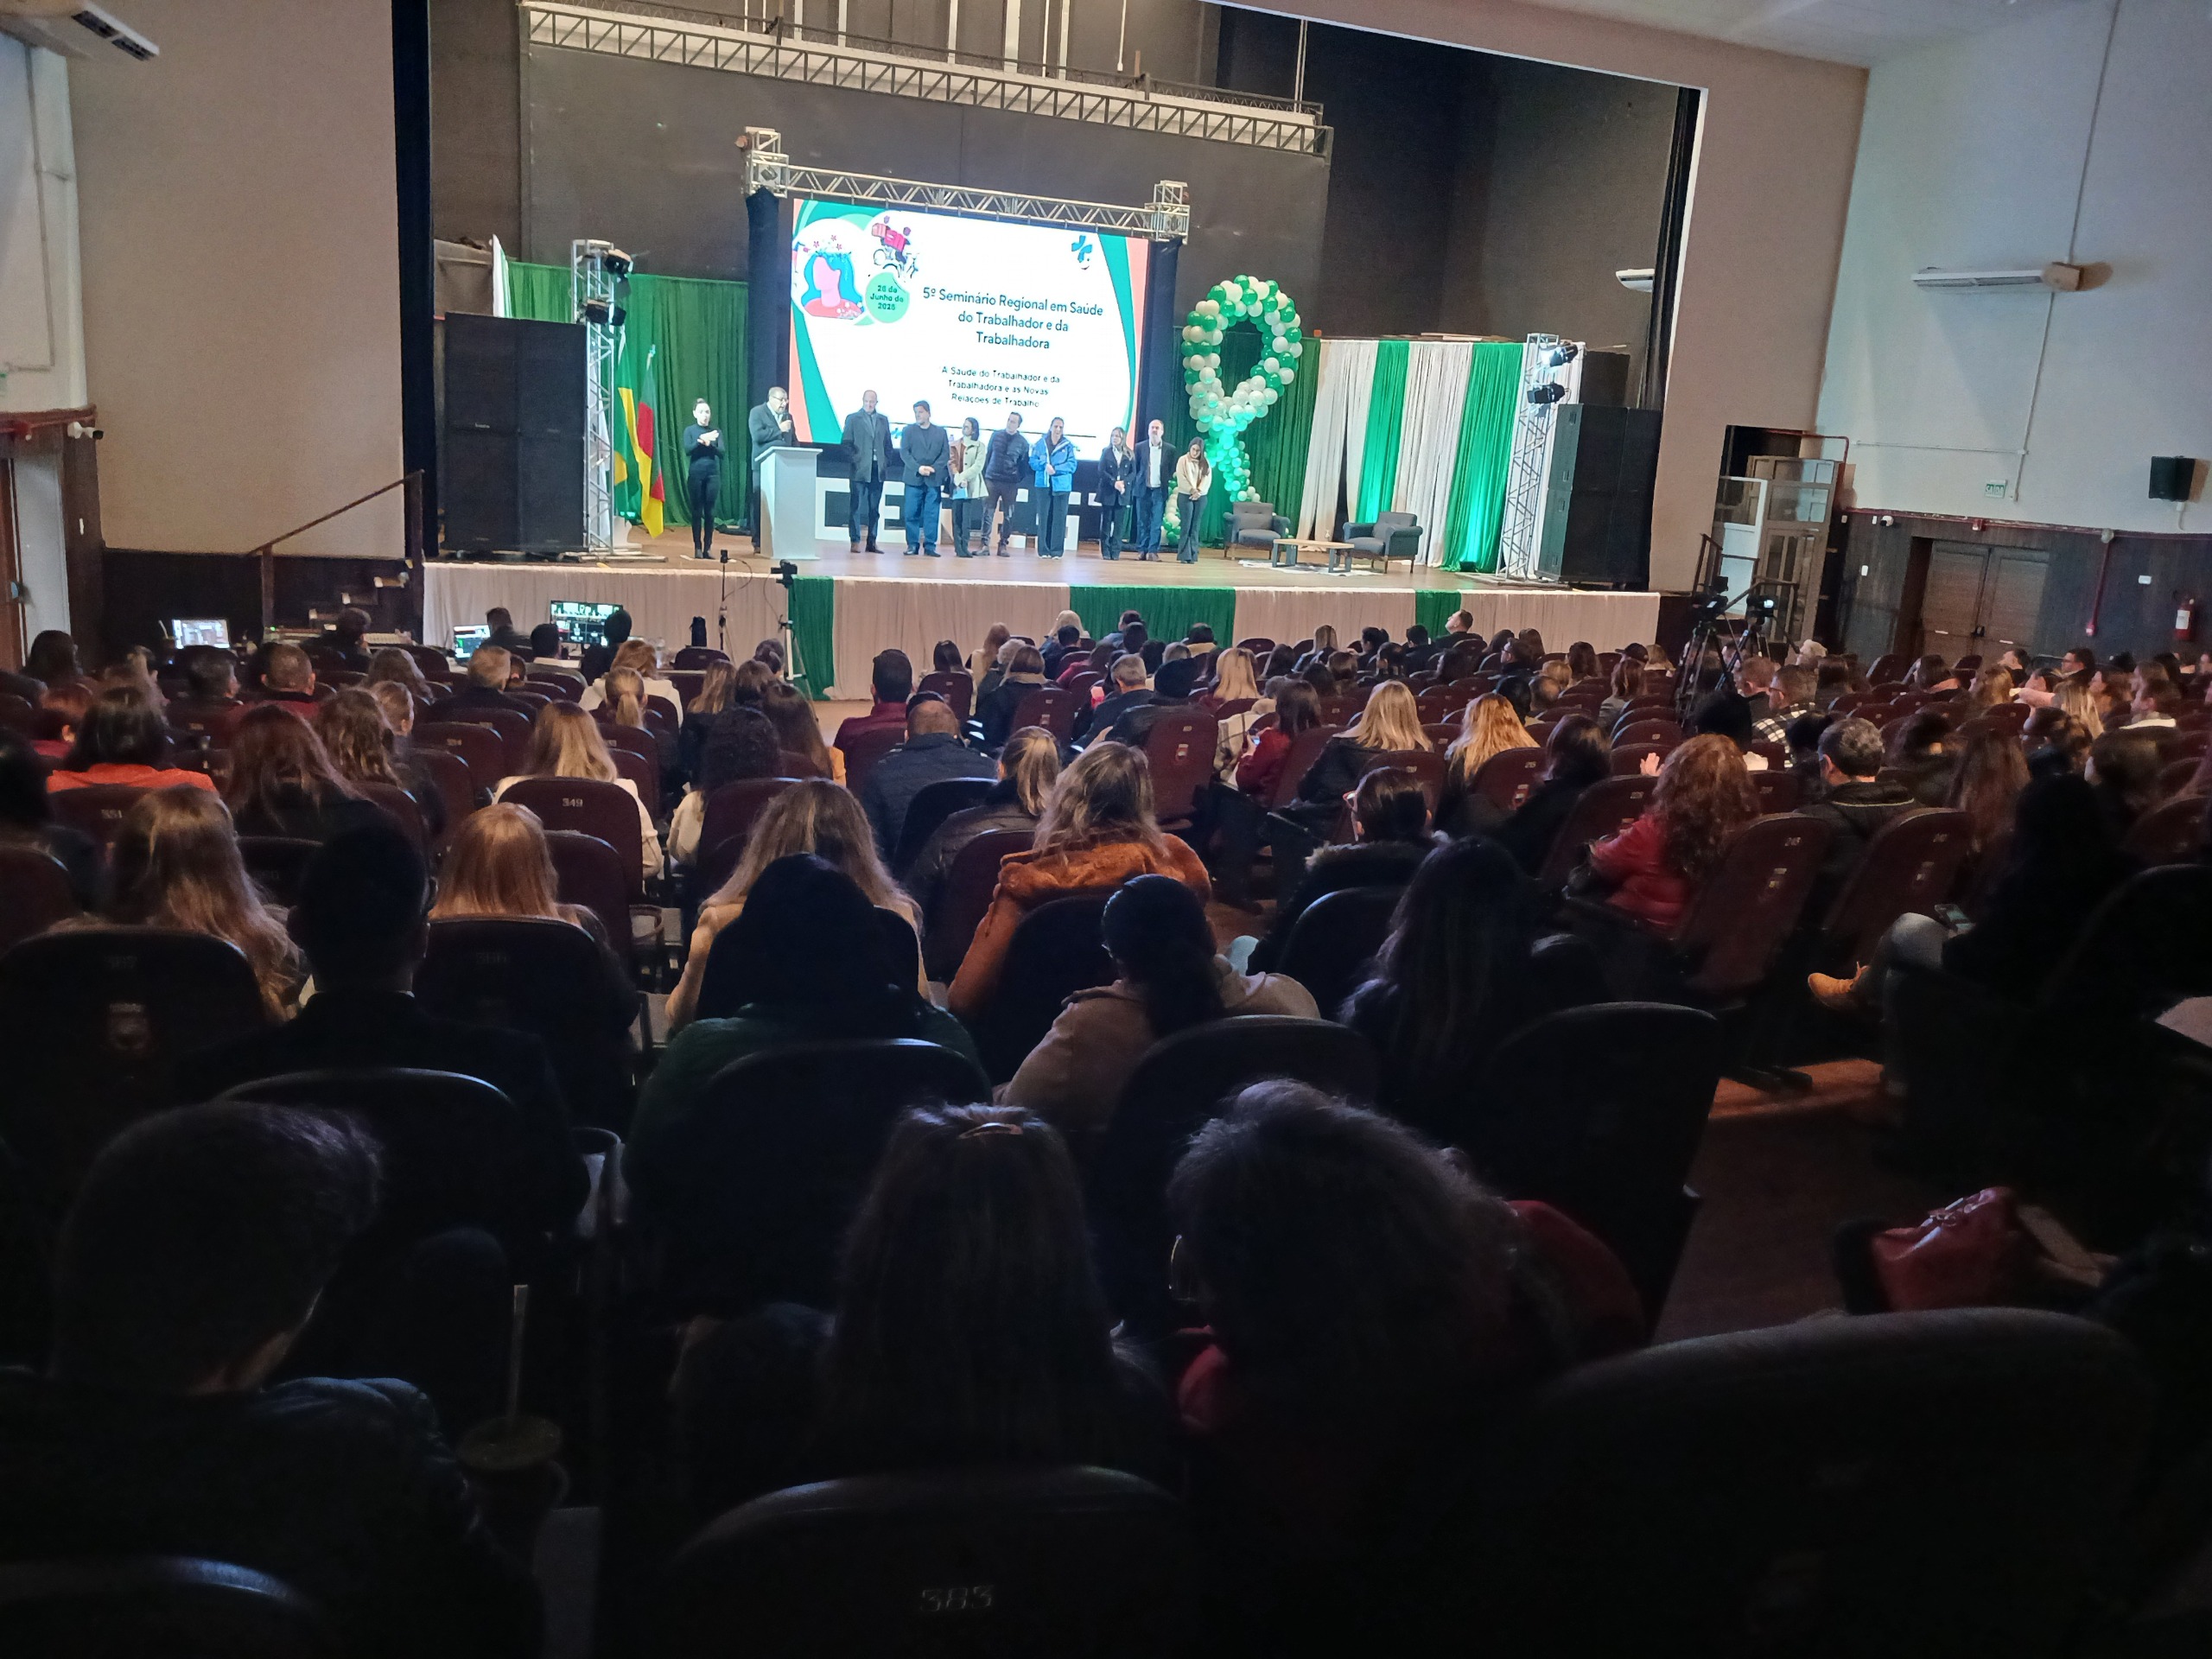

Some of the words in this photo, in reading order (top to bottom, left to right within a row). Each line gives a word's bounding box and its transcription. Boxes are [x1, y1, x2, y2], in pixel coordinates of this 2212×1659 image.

[869, 293, 893, 302] Junho
[938, 288, 996, 306] Seminário
[999, 294, 1047, 312] Regional
[1050, 302, 1067, 313] em
[1070, 302, 1103, 316] Saúde
[957, 310, 973, 323] do
[976, 311, 1044, 330] Trabalhador
[1046, 321, 1052, 330] e
[1055, 319, 1069, 332] da
[976, 331, 1050, 349] Trabalhadora
[942, 365, 948, 374] A
[979, 369, 990, 378] do
[993, 370, 1041, 382] Trabalhador
[948, 379, 1002, 392] Trabalhadora
[1023, 385, 1049, 396] Novas
[1005, 397, 1039, 408] Trabalho
[562, 798, 583, 807] 349
[919, 1585, 994, 1613] 383
